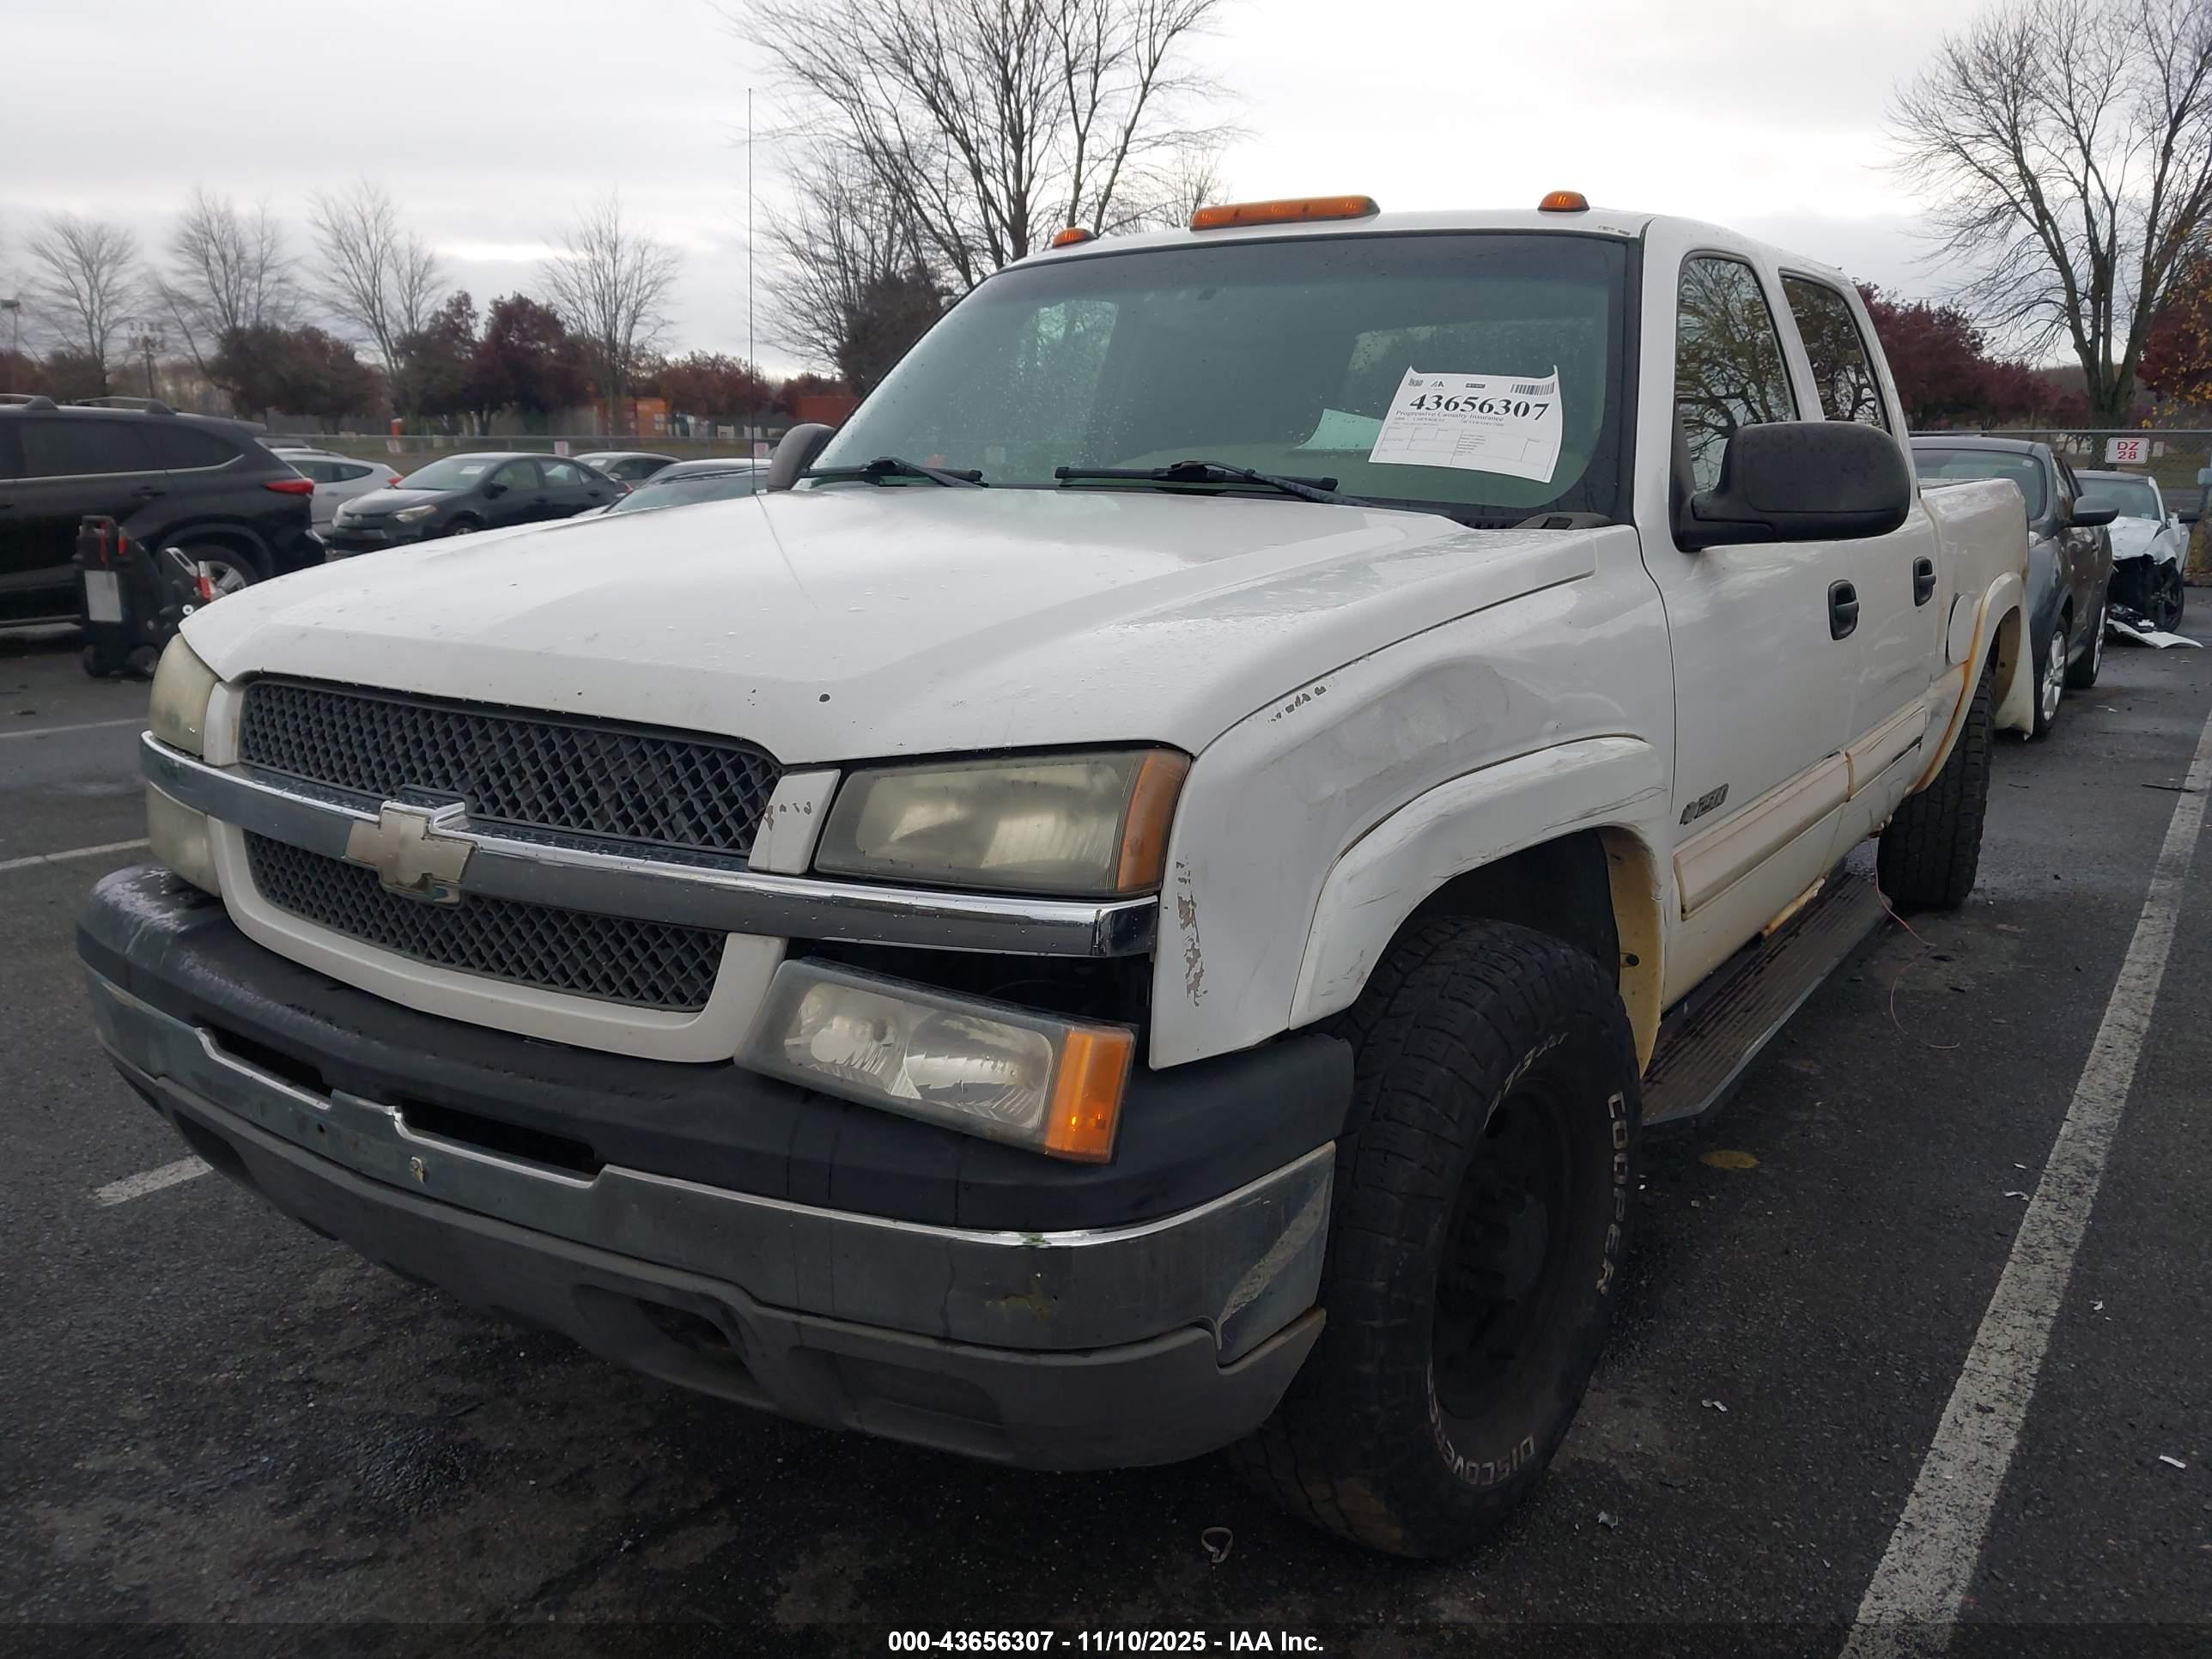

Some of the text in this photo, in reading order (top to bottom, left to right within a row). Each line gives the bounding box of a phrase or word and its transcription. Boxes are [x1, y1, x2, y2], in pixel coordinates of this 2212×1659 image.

[1409, 393, 1550, 422] 43656307
[1469, 413, 1504, 422] Insurance
[2117, 441, 2139, 451] DZ
[2118, 451, 2137, 460] 28
